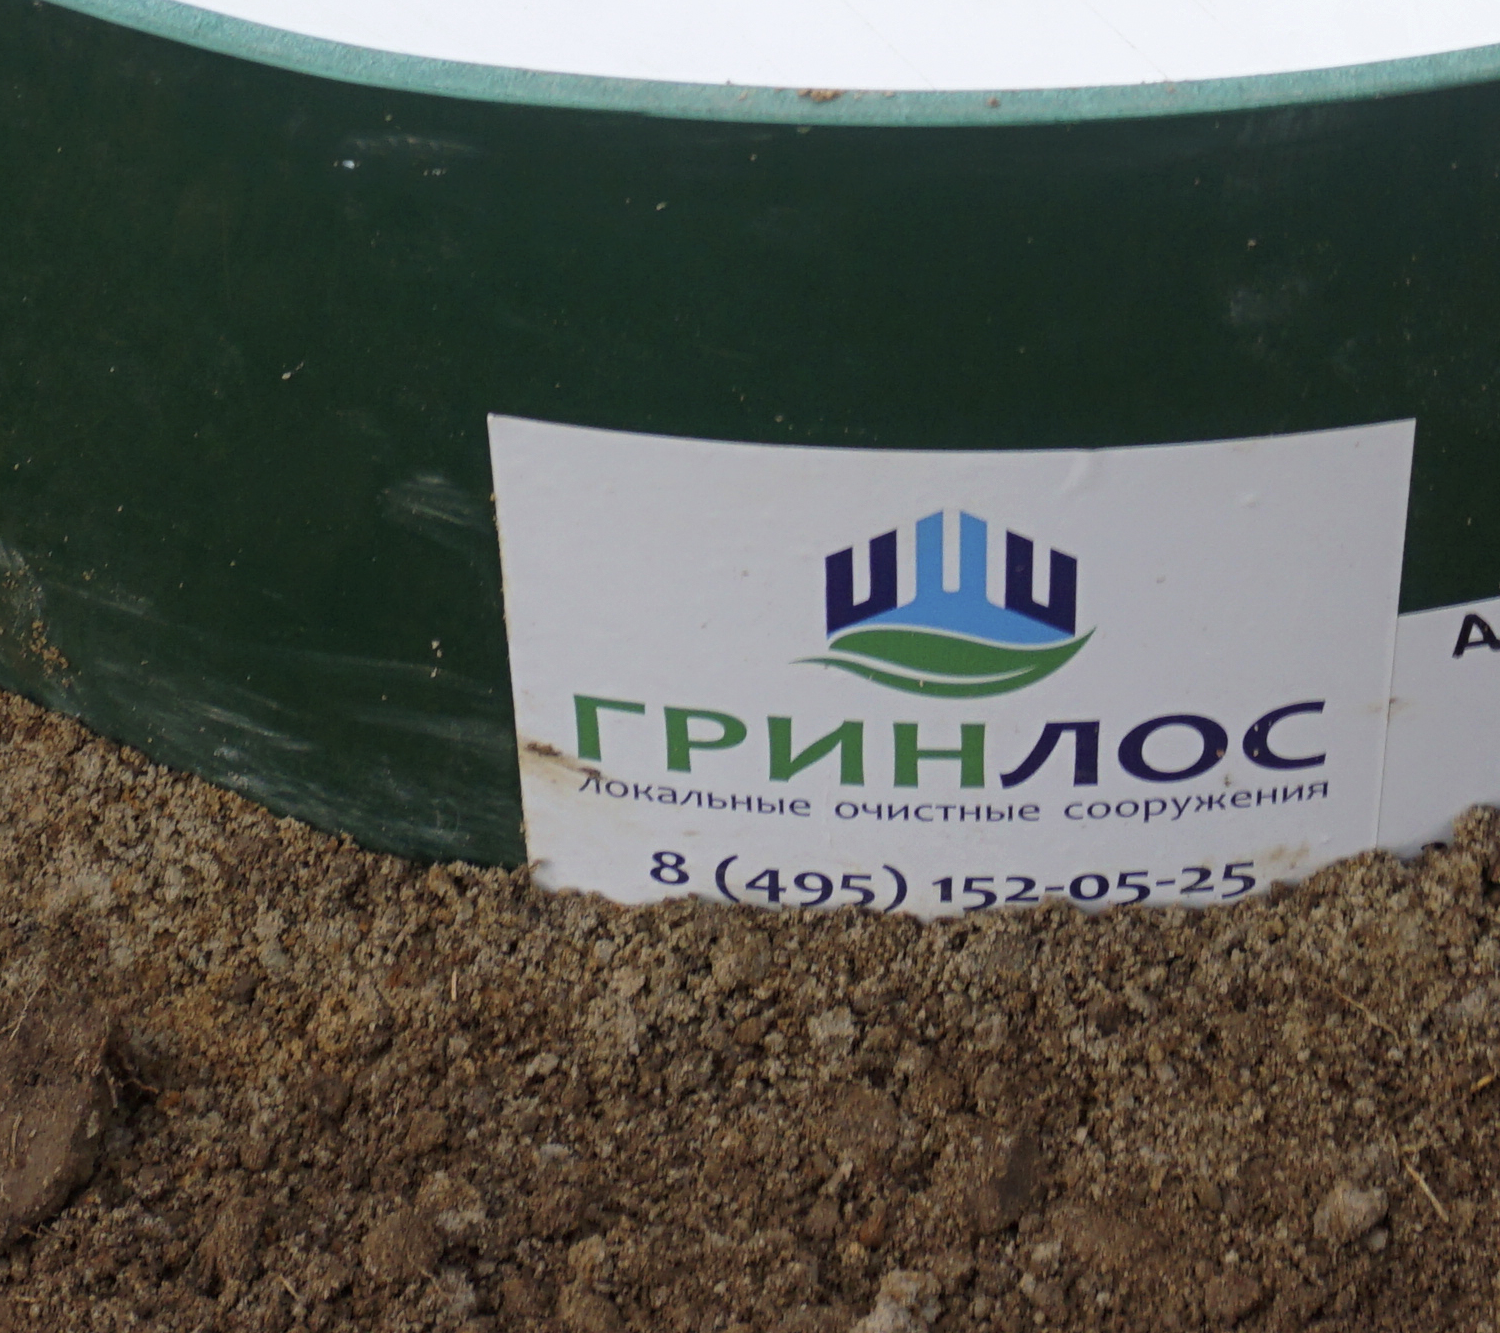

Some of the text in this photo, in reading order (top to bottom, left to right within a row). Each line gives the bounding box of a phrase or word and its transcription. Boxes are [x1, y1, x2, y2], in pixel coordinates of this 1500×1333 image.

[573, 694, 1327, 789] ГРИНЛОС
[579, 773, 1329, 823] локальные очистные сооружения
[649, 850, 1257, 914] 8 (495) 152-05-25
